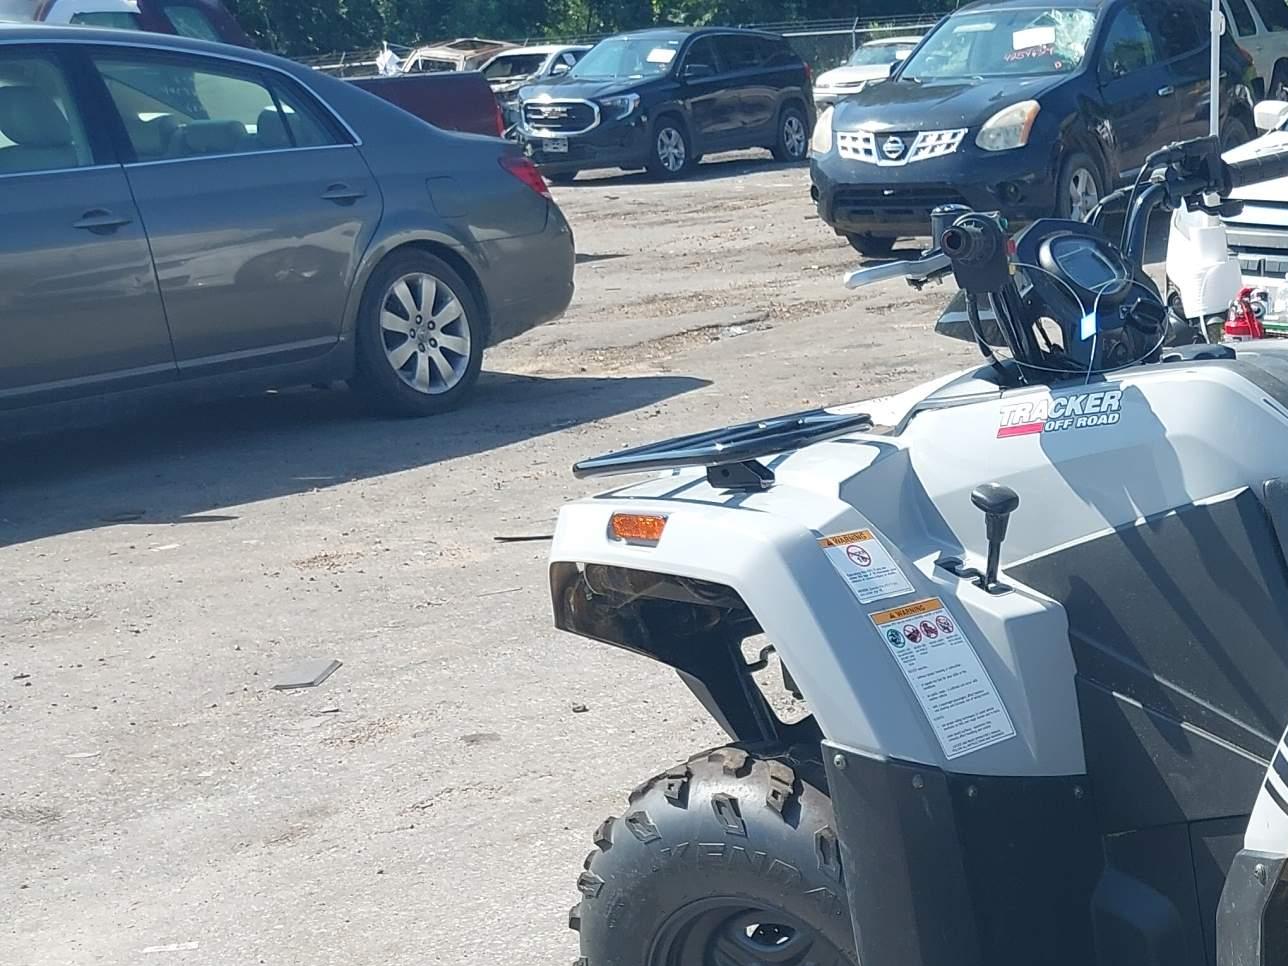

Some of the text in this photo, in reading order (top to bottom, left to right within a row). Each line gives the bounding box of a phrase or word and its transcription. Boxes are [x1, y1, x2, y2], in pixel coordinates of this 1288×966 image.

[1000, 391, 1122, 427] TRACKER
[1044, 412, 1120, 432] OFF ROAD
[834, 531, 869, 545] WARNING
[896, 604, 926, 618] WARNING
